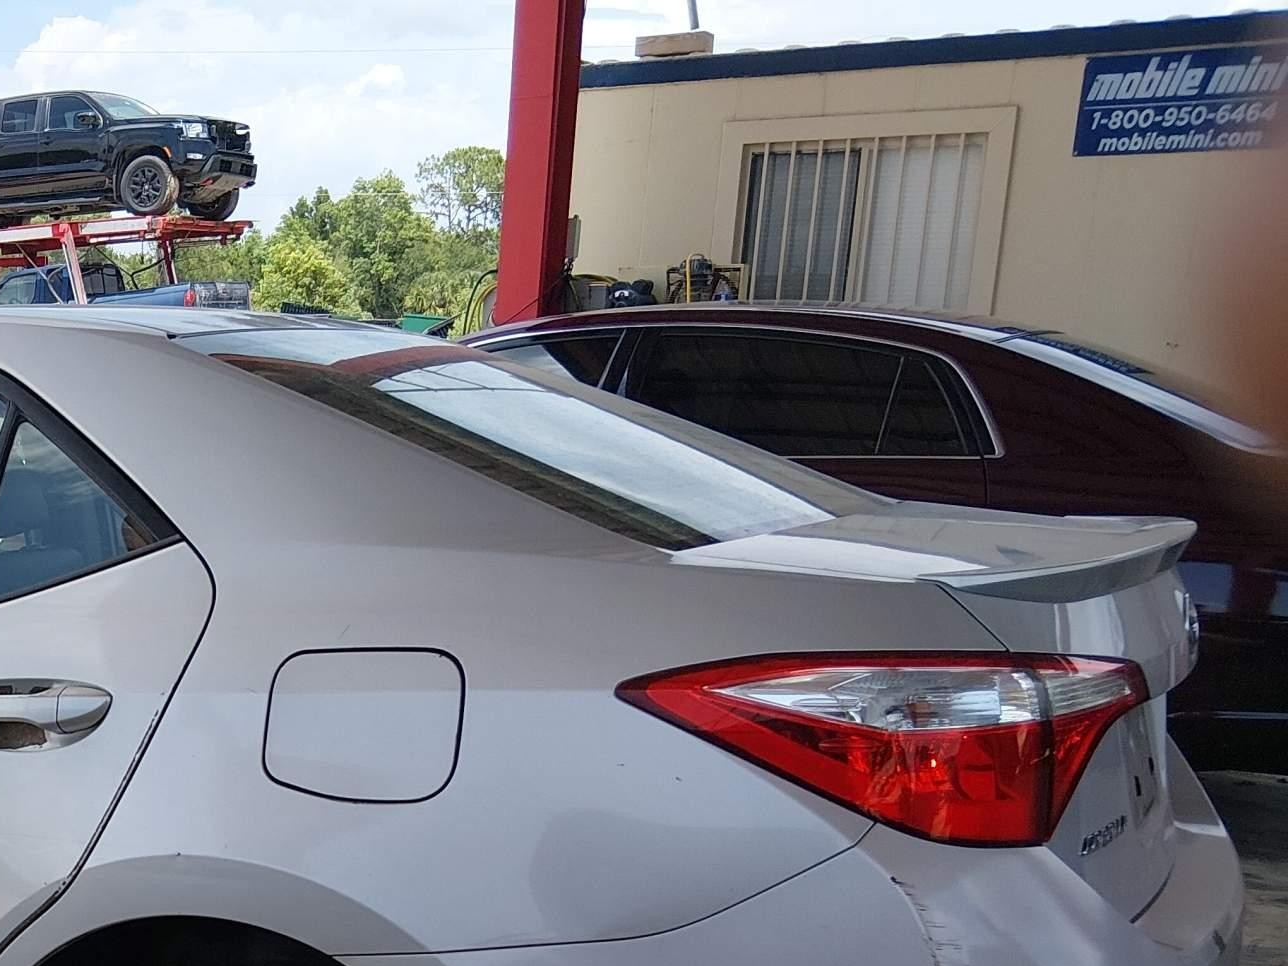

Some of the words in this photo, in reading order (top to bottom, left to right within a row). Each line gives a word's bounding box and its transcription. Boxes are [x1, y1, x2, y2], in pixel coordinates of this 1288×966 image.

[1086, 54, 1205, 102] mobile
[1205, 55, 1288, 95] mini
[1090, 101, 1278, 131] 1-800-950-6464
[1097, 129, 1262, 153] mobilemini.com
